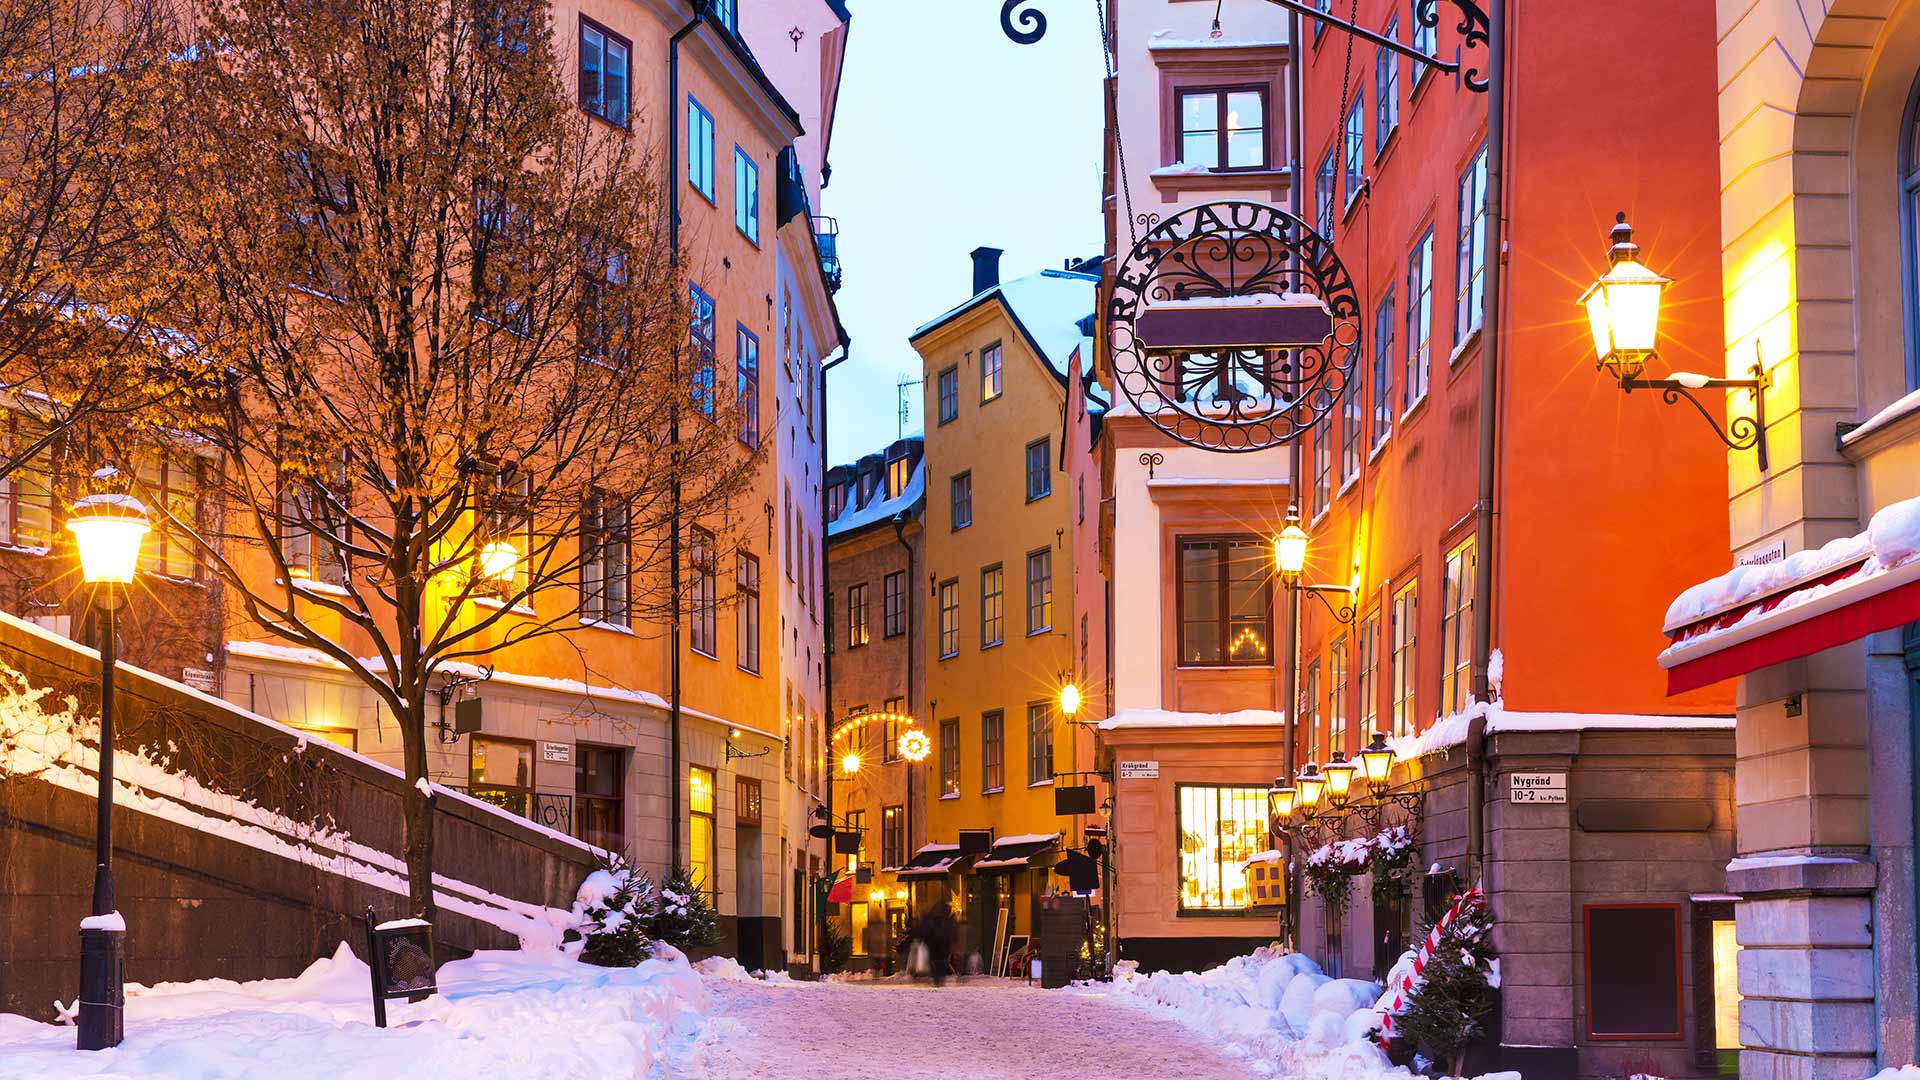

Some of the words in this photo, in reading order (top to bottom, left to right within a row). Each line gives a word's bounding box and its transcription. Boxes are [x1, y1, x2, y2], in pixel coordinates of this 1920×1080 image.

[1110, 203, 1359, 325] RESTAURANG
[1513, 775, 1551, 788] Nygränd
[1513, 790, 1535, 801] 10-2
